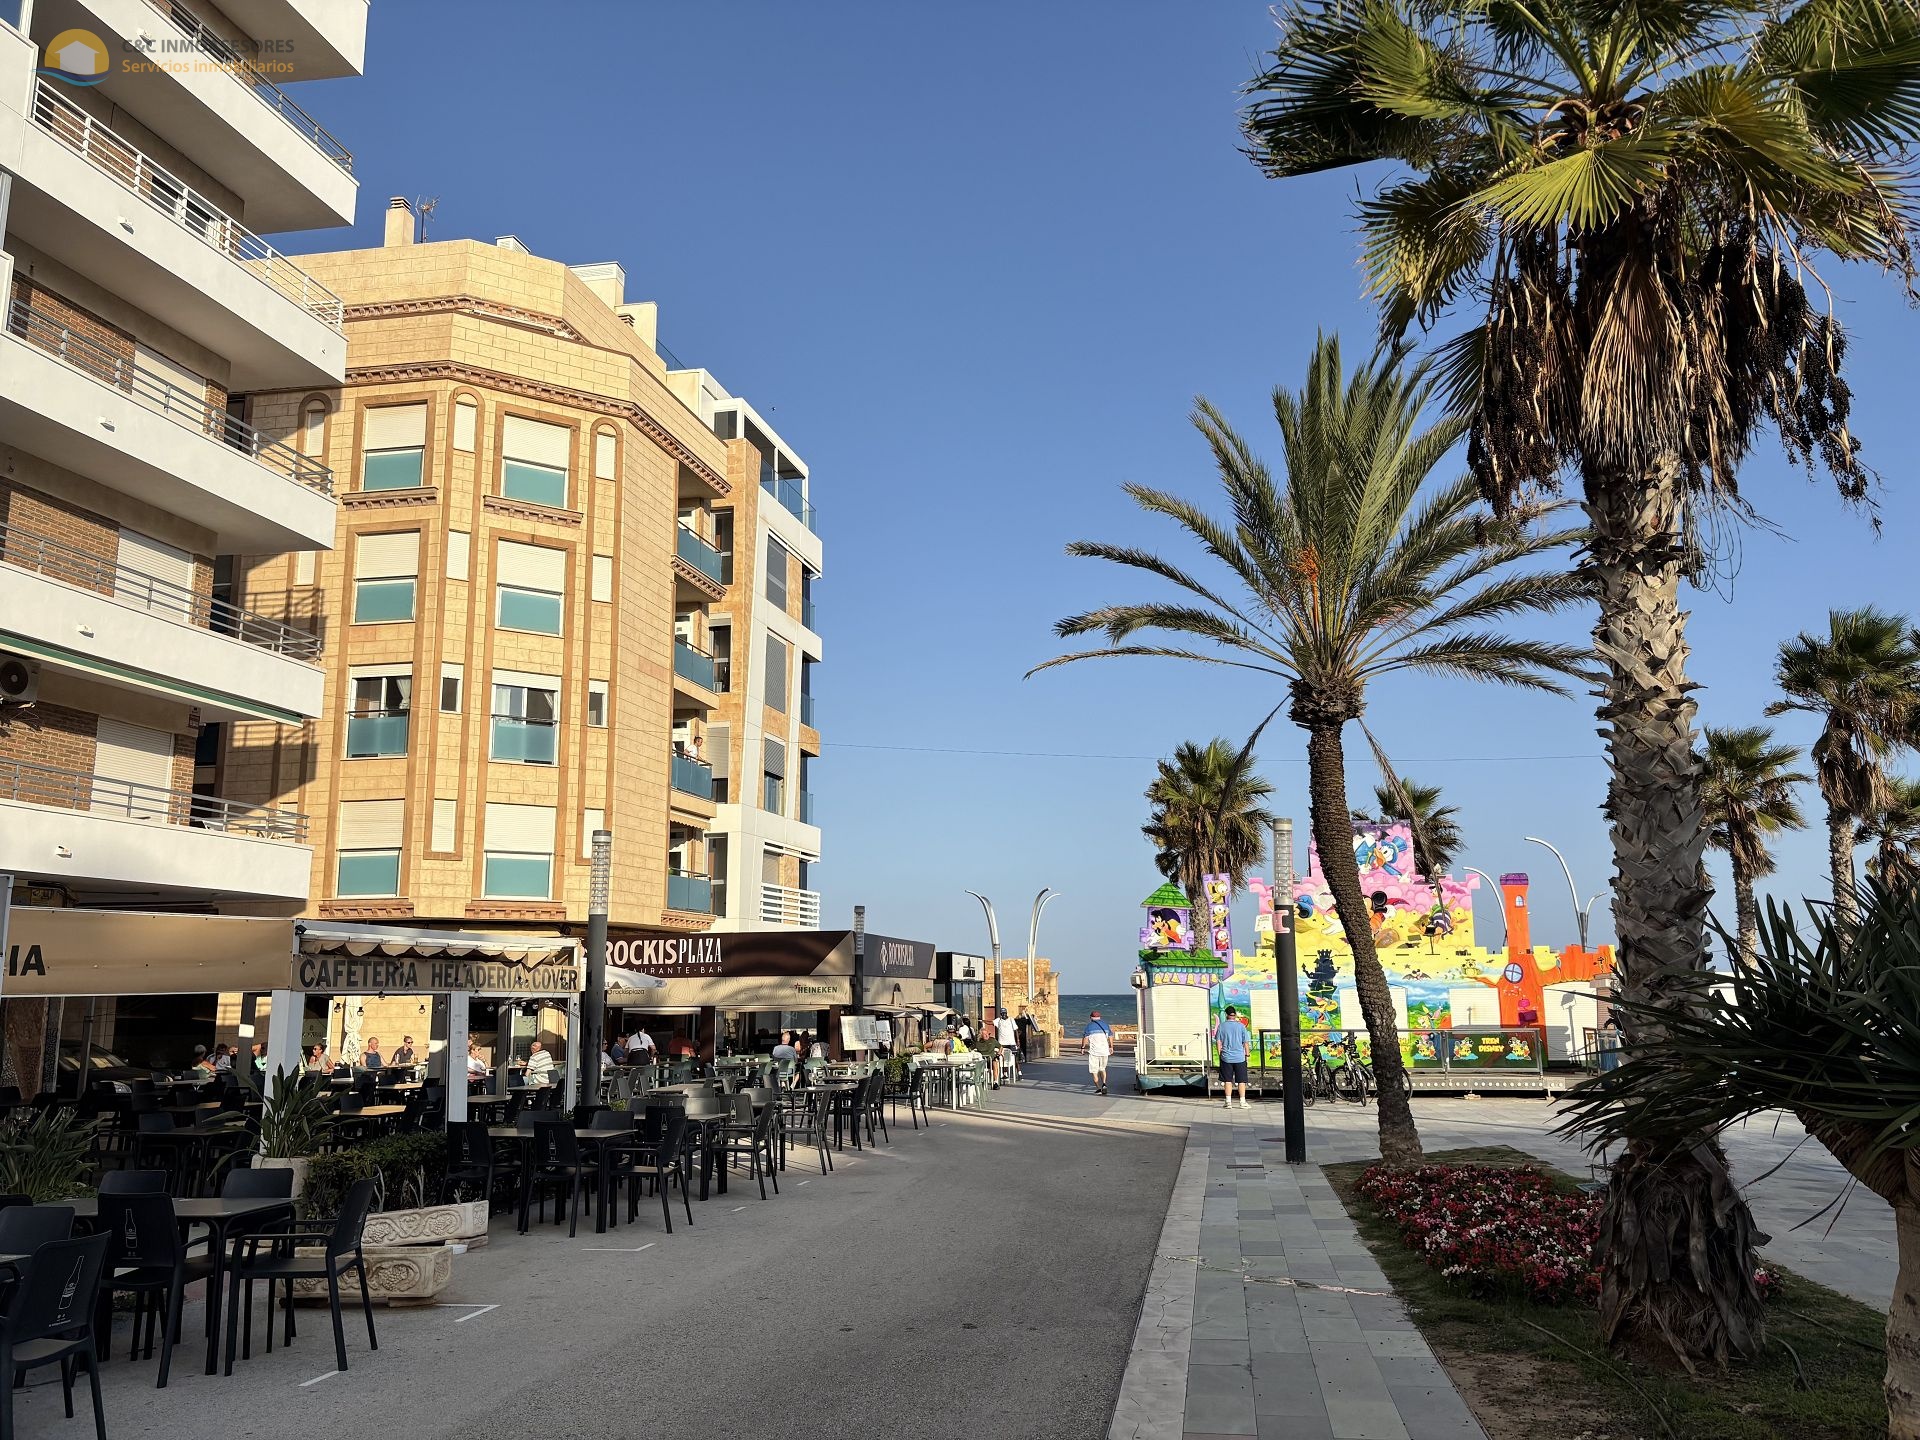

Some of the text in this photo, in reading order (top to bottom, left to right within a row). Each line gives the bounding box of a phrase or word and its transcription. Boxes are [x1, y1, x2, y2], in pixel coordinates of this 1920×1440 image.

[699, 965, 723, 974] BAR
[431, 962, 523, 990] HELADERIA
[532, 967, 579, 991] COVER
[797, 986, 838, 994] HEINEKEN
[1481, 1037, 1500, 1045] TREN
[1478, 1045, 1505, 1053] DISNEY
